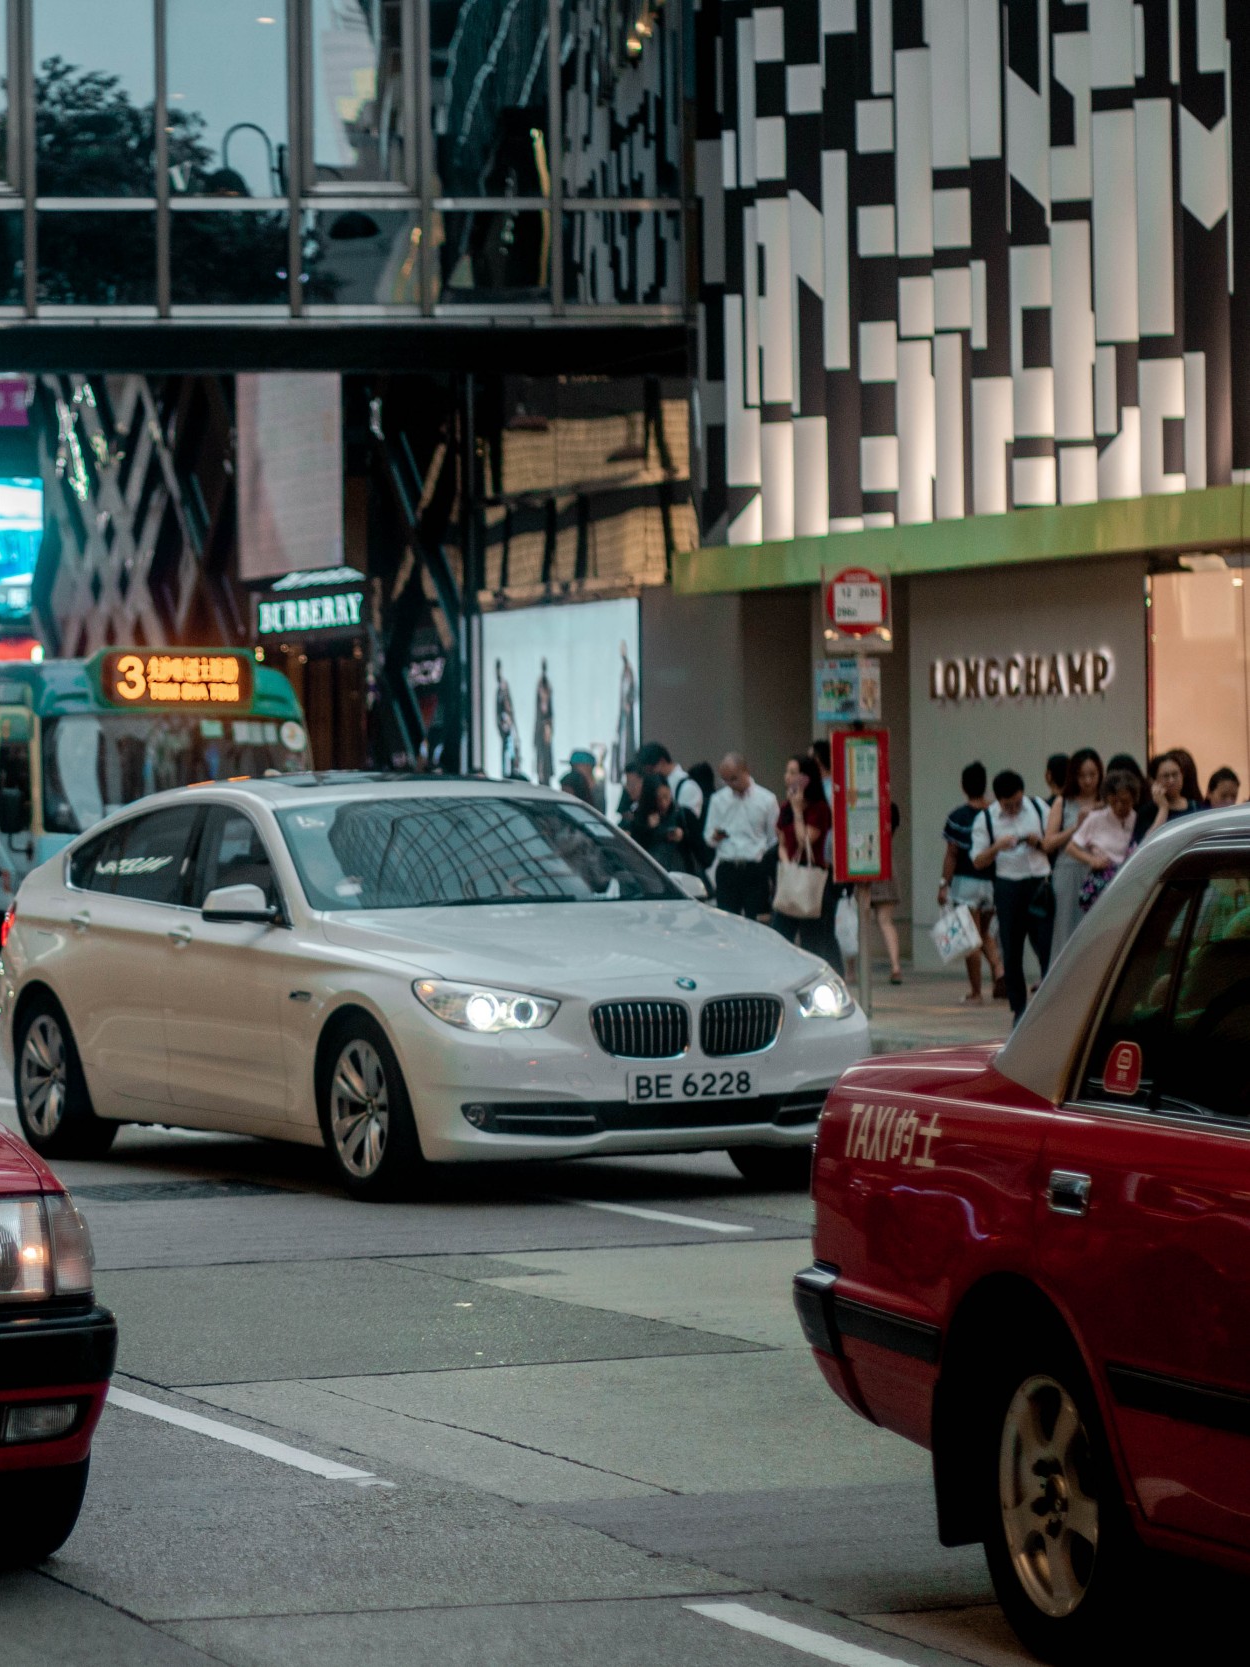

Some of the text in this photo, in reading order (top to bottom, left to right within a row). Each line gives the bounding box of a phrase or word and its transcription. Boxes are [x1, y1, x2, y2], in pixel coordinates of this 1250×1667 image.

[258, 592, 364, 634] BURBERRY
[116, 655, 147, 700] 3
[929, 648, 1113, 701] LONGCHAMP
[635, 1070, 752, 1099] BE 6228
